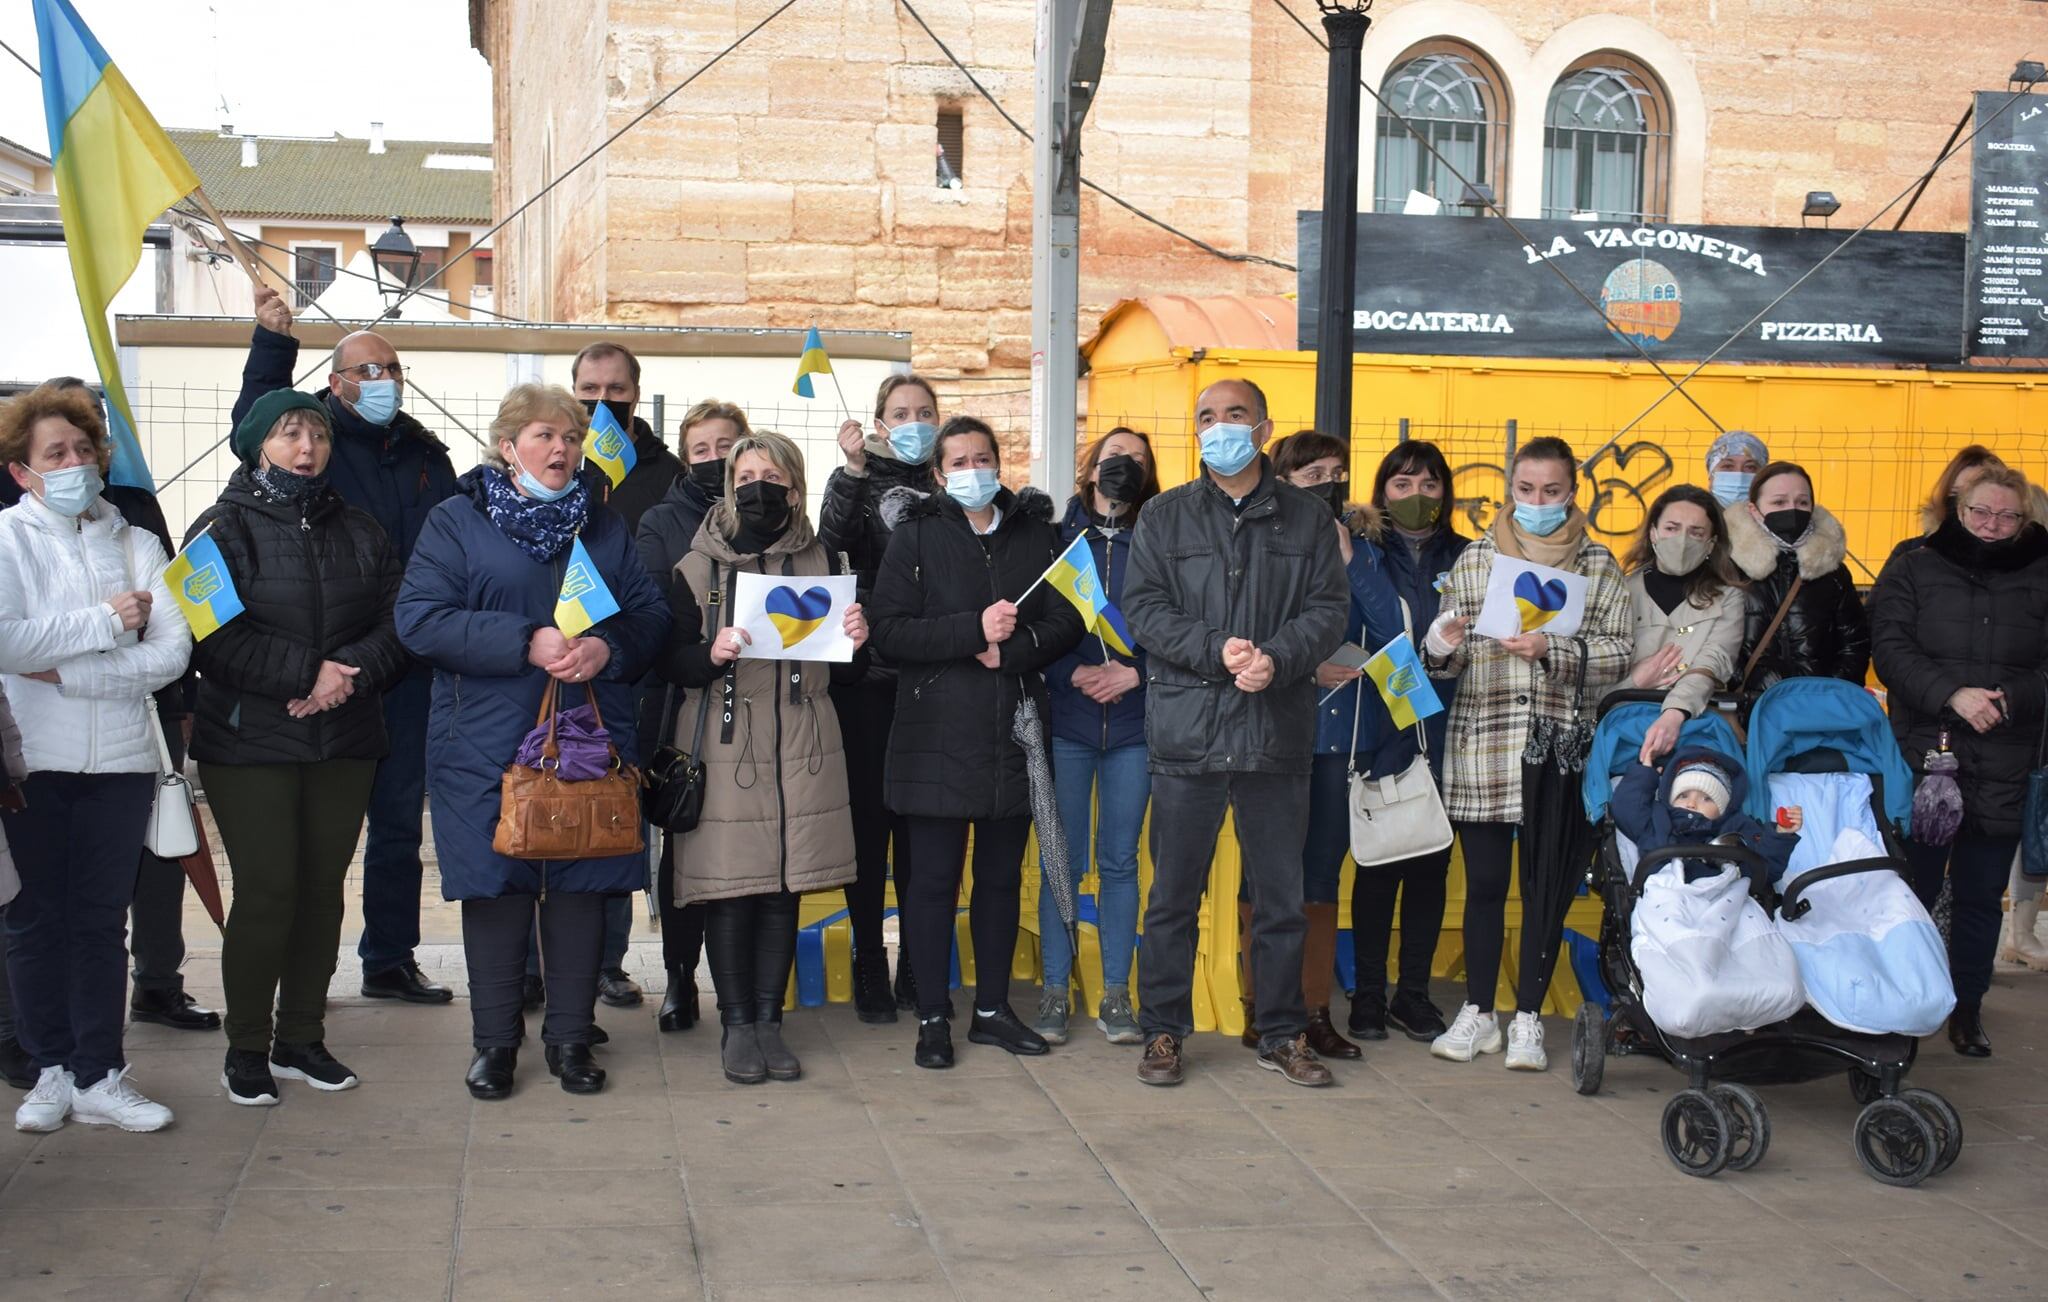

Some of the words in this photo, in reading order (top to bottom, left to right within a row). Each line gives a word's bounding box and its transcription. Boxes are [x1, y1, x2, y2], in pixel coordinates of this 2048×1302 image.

[2020, 106, 2042, 121] LA
[1987, 142, 2036, 152] BOCATERIA
[1523, 236, 1576, 264] LA
[1584, 228, 1767, 276] VAGONETA
[2015, 268, 2042, 276] QUESO
[1353, 310, 1515, 333] BOCATERIA
[1760, 322, 1883, 342] PIZZERIA
